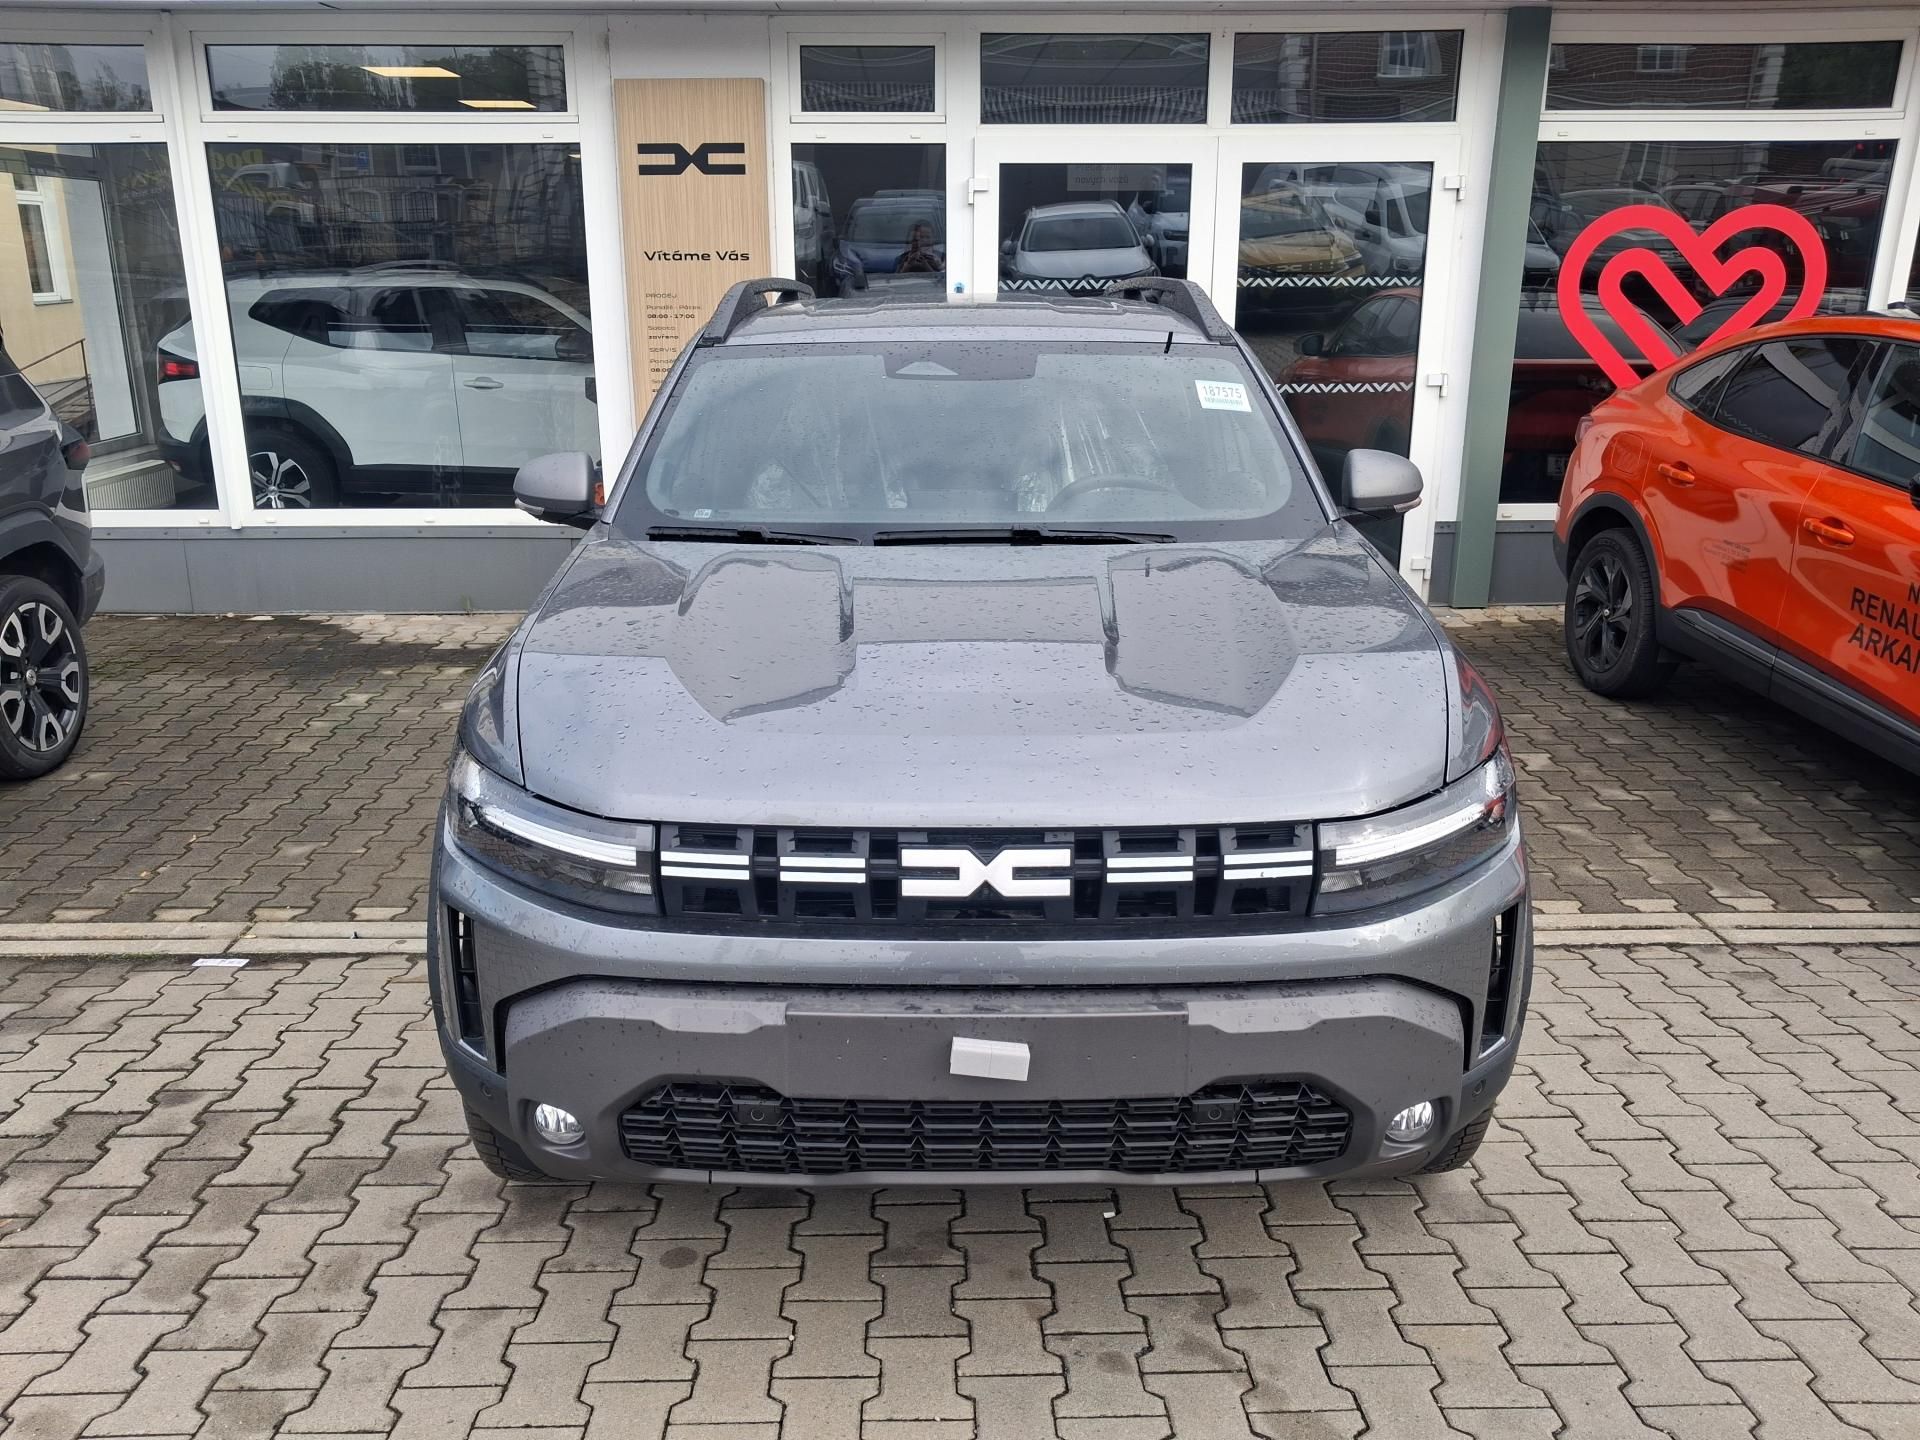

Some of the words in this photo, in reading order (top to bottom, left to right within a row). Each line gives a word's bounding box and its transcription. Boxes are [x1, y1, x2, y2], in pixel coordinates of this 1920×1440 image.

[644, 250, 711, 262] Vítáme
[715, 250, 750, 262] Vás
[1201, 385, 1242, 399] 187575
